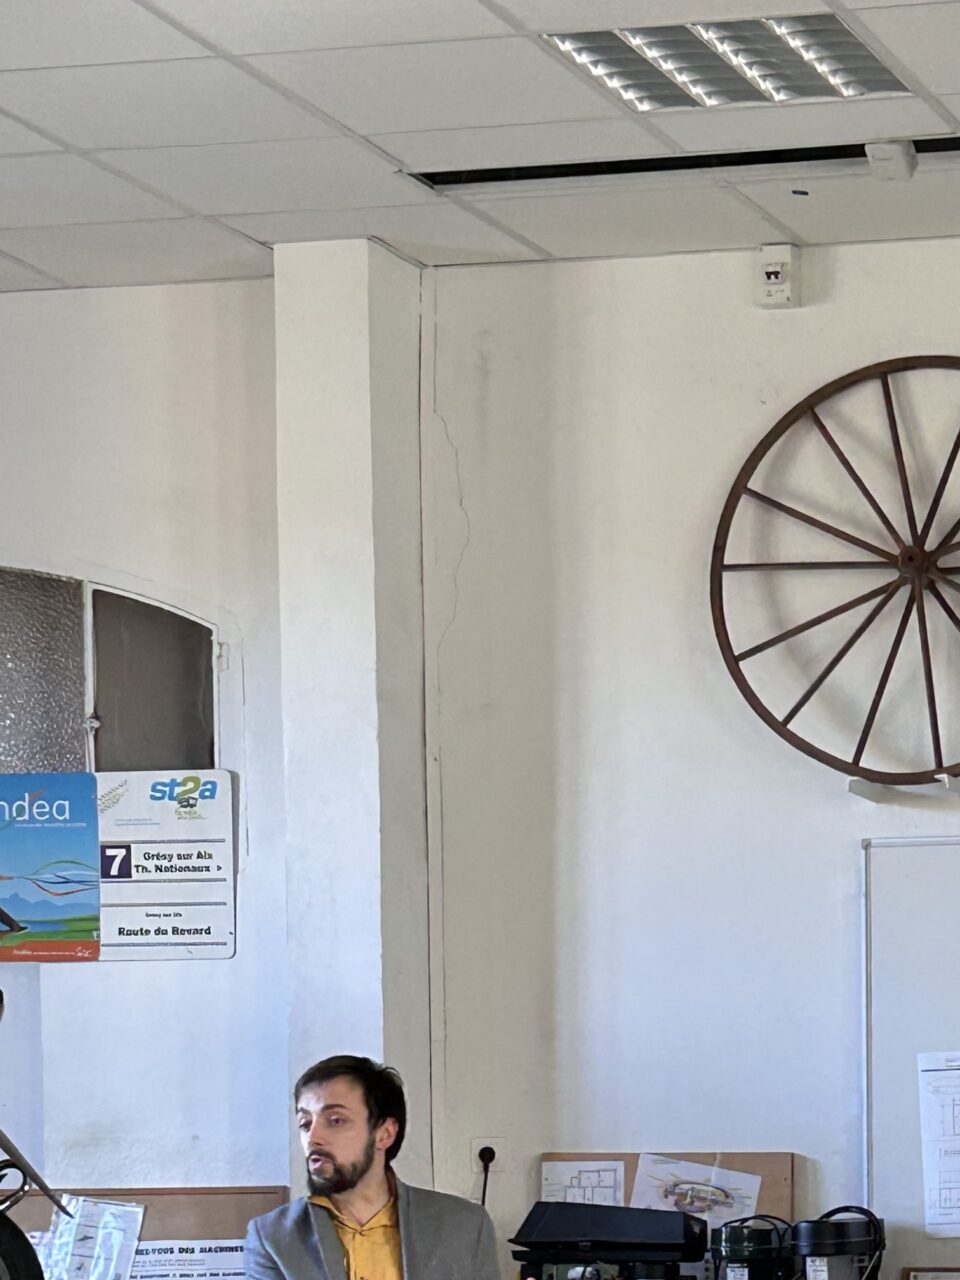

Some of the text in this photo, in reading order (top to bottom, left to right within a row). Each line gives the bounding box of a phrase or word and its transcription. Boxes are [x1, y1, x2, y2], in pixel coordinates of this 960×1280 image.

[149, 776, 218, 801] st2a
[105, 848, 126, 876] 7
[176, 853, 194, 861] sur
[134, 864, 211, 874] Th. Nationaux
[118, 926, 212, 937] Route du Revard
